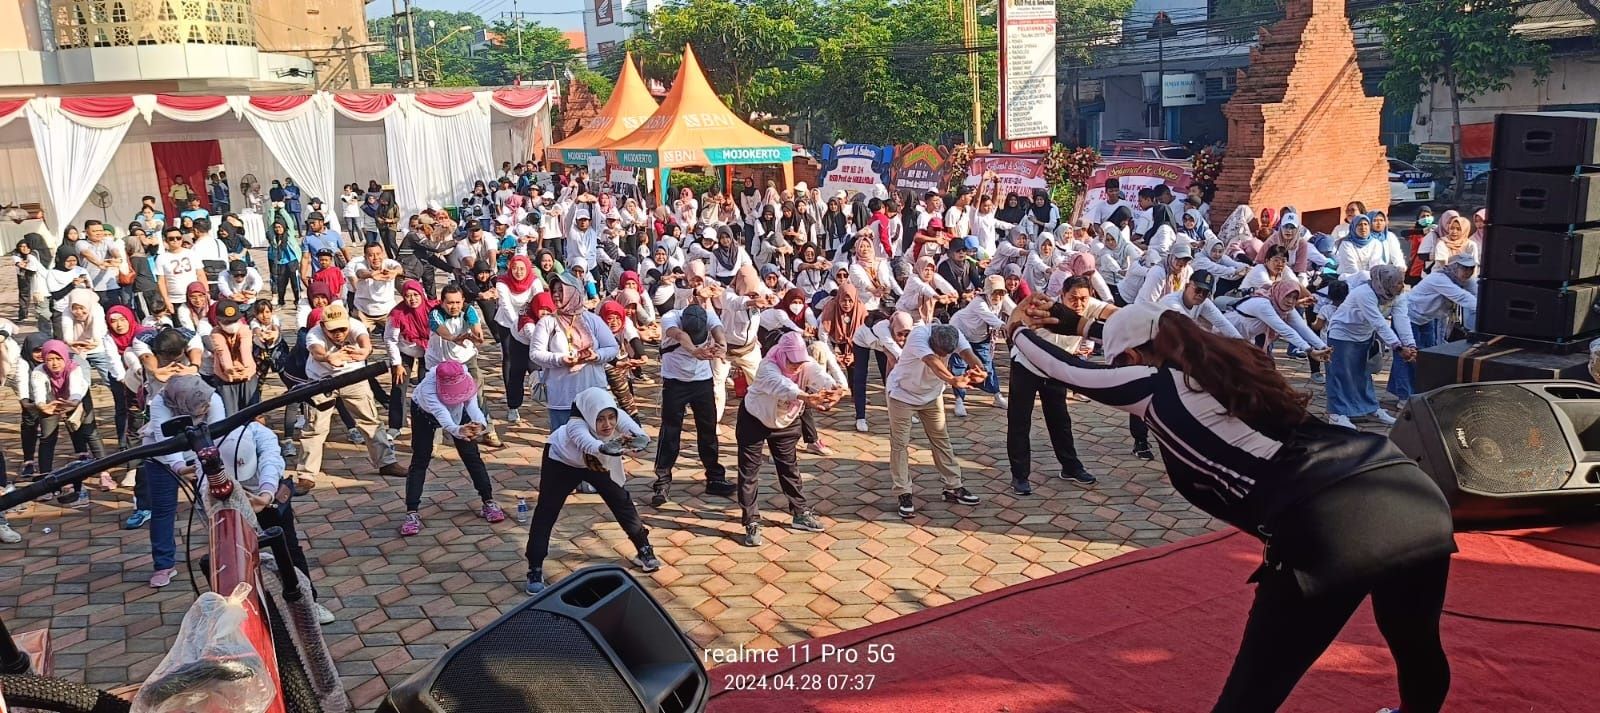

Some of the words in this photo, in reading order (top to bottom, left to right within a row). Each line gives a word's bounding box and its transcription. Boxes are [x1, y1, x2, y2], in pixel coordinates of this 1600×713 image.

[702, 113, 736, 127] BNI
[623, 152, 653, 163] MOJOKERTO
[675, 150, 697, 162] BNI
[722, 149, 780, 160] MOJOKERTO
[1108, 165, 1141, 177] Selamat
[1142, 166, 1152, 175] &
[1154, 166, 1179, 180] Sukses
[170, 257, 192, 275] 23
